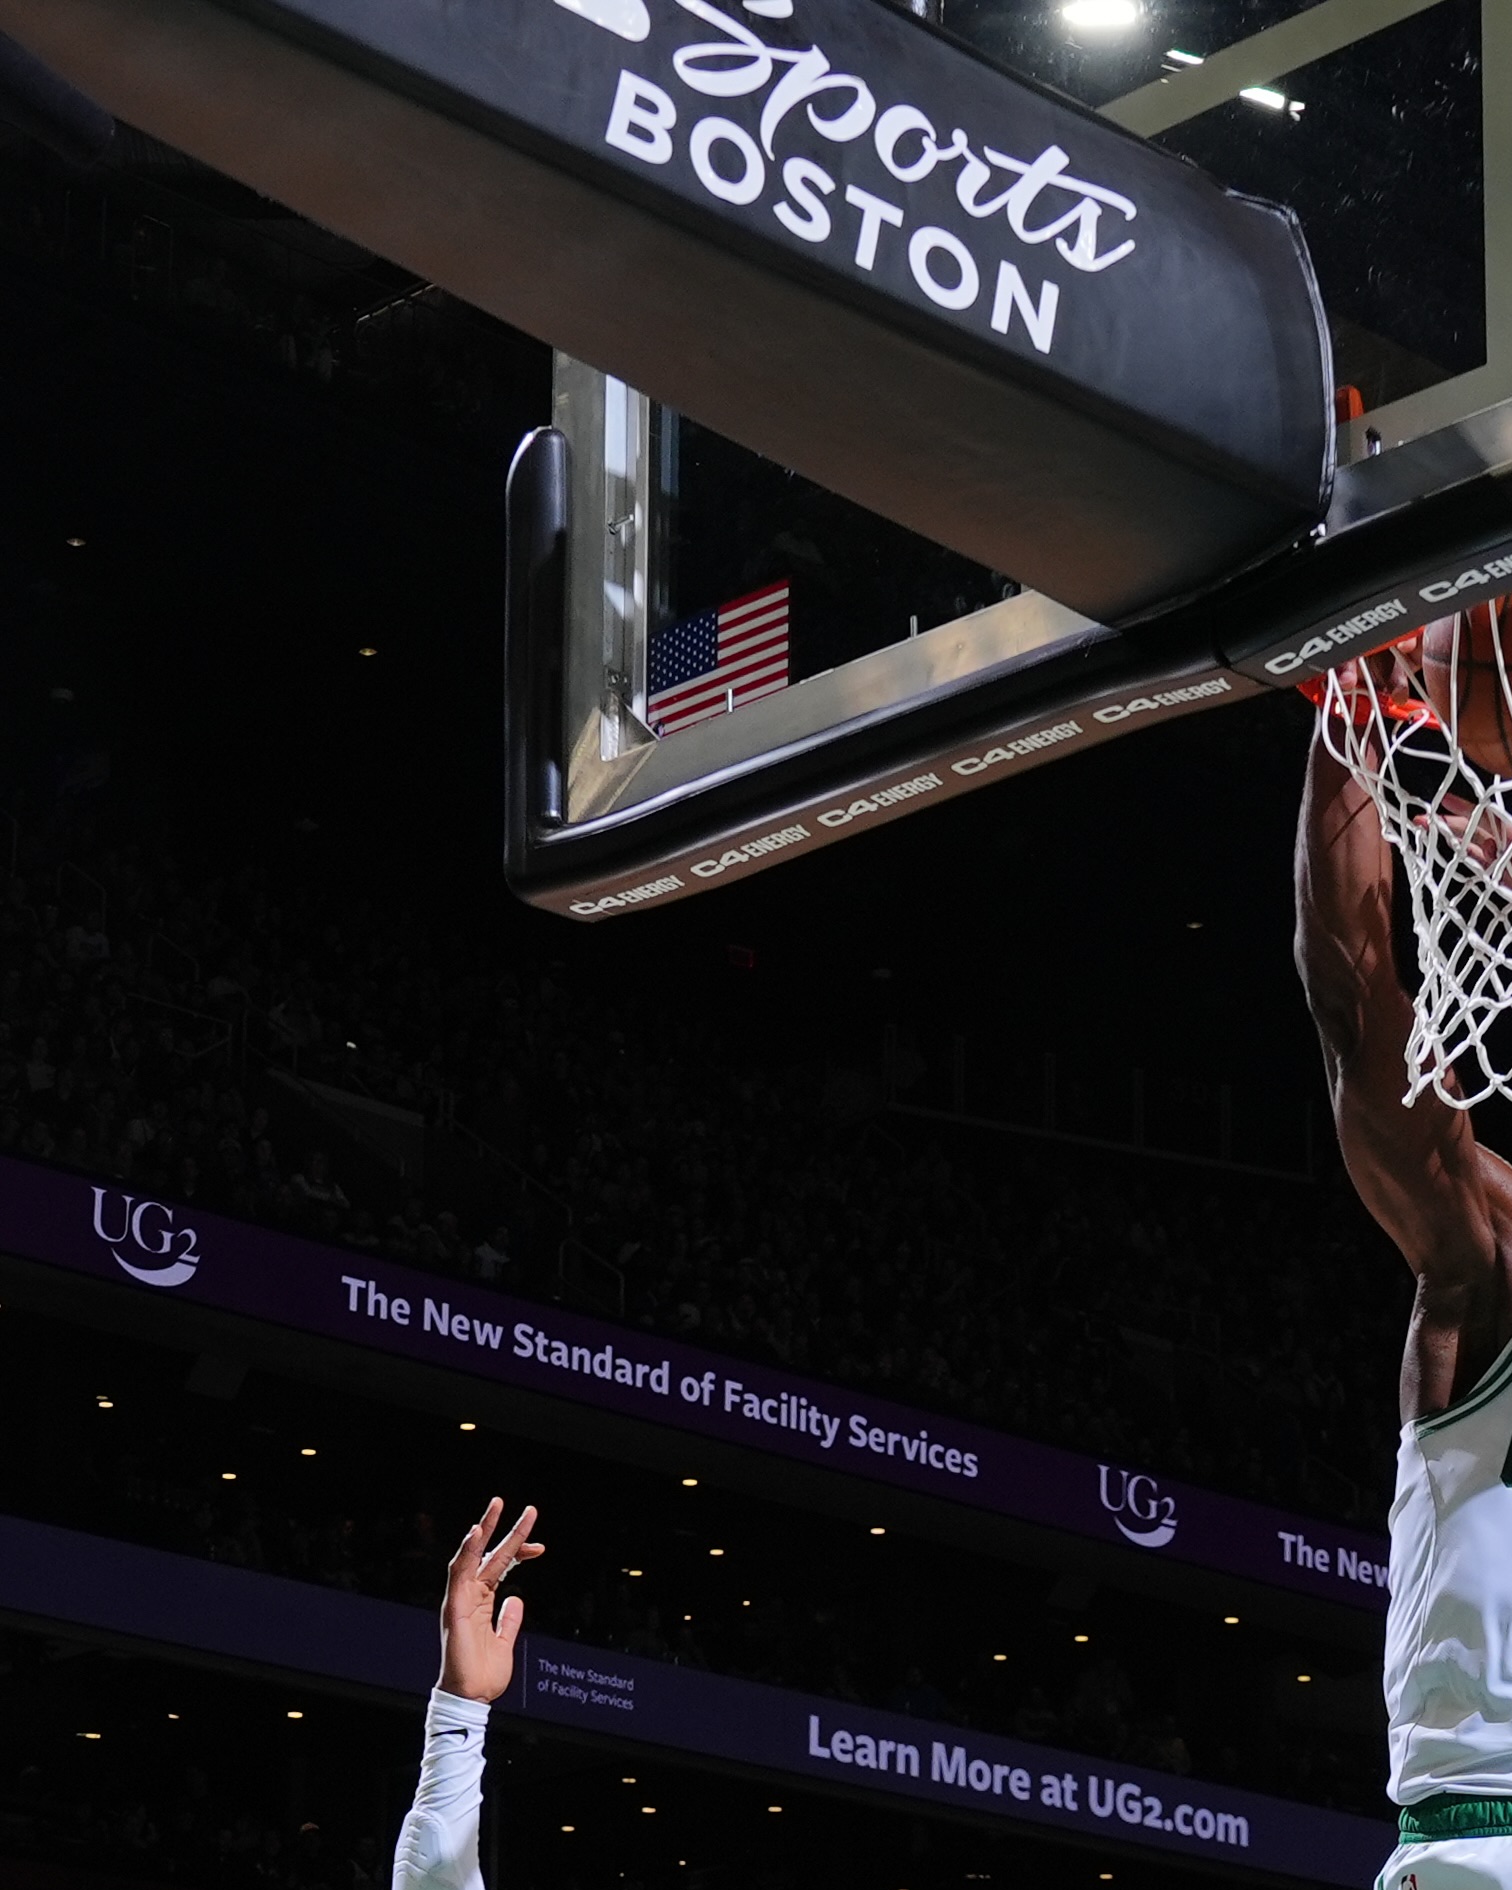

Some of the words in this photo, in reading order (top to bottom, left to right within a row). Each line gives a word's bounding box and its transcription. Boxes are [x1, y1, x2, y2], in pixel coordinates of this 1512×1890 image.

[672, 0, 1137, 272] Sports
[605, 69, 1061, 354] BOSTON
[1327, 599, 1408, 645] ENERGY
[1154, 677, 1232, 707] ENERGY
[1008, 720, 1083, 755] ENERGY
[870, 772, 944, 807] ENERGY
[742, 825, 811, 857] ENERGY
[618, 875, 685, 904] ENERGY
[90, 1186, 200, 1264] UG2
[342, 1275, 410, 1325] The
[423, 1298, 503, 1350] New
[513, 1323, 670, 1395] Standard
[680, 1372, 716, 1406] of
[724, 1380, 840, 1449] Facility
[848, 1414, 979, 1478] Services
[1097, 1464, 1178, 1527] UG2
[1278, 1531, 1330, 1573] The
[537, 1678, 550, 1693] of
[551, 1680, 588, 1704] Facility
[590, 1689, 635, 1711] Services
[538, 1658, 559, 1677] The
[561, 1663, 585, 1681] New
[587, 1669, 635, 1691] Standard
[809, 1714, 920, 1778] Learn
[931, 1741, 1031, 1801] More
[1040, 1772, 1078, 1811] at
[1088, 1775, 1249, 1848] UG2.com
